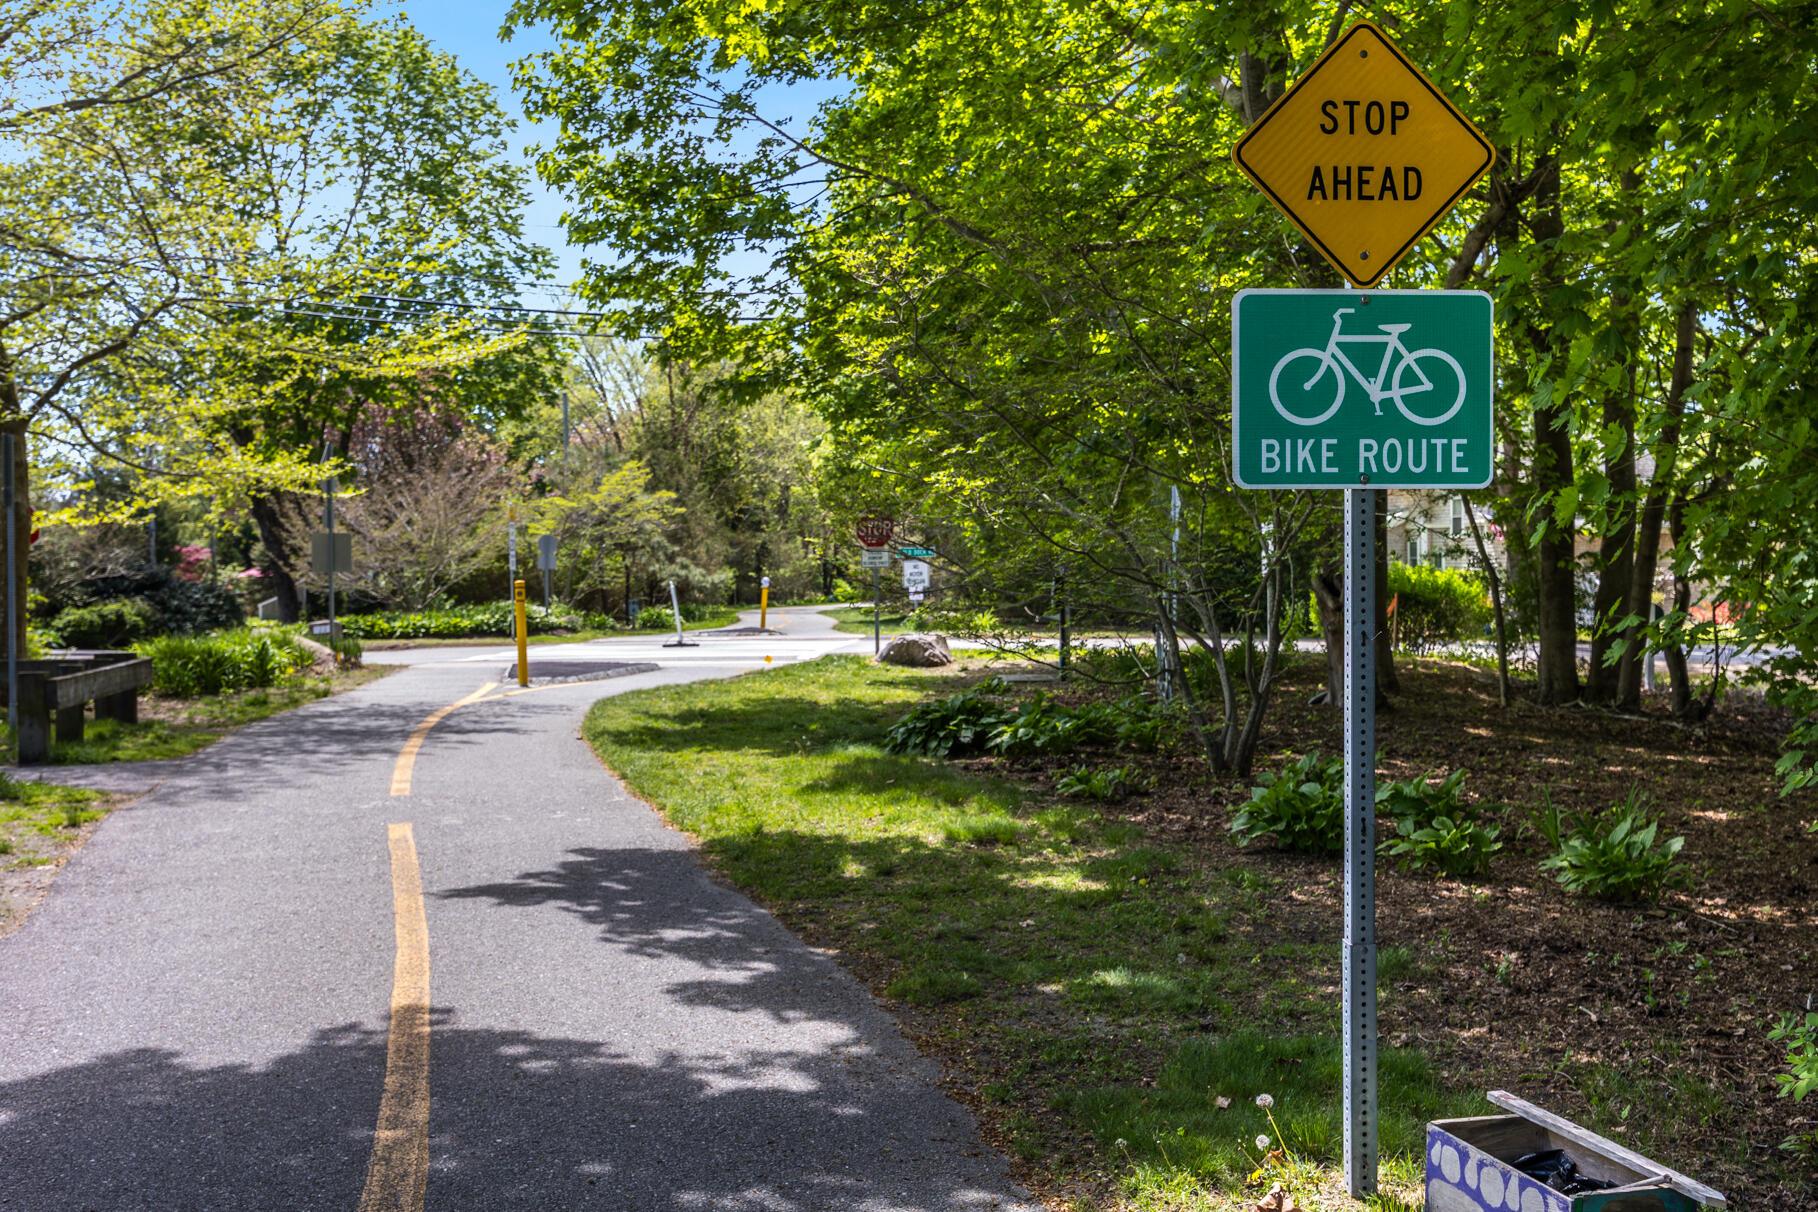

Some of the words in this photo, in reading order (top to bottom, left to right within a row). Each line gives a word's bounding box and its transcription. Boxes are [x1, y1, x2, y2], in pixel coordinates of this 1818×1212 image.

[1320, 100, 1410, 135] STOP
[1307, 166, 1423, 201] AHEAD
[1260, 438, 1339, 473] BIKE
[1359, 438, 1469, 473] ROUTE
[859, 521, 892, 536] STOP
